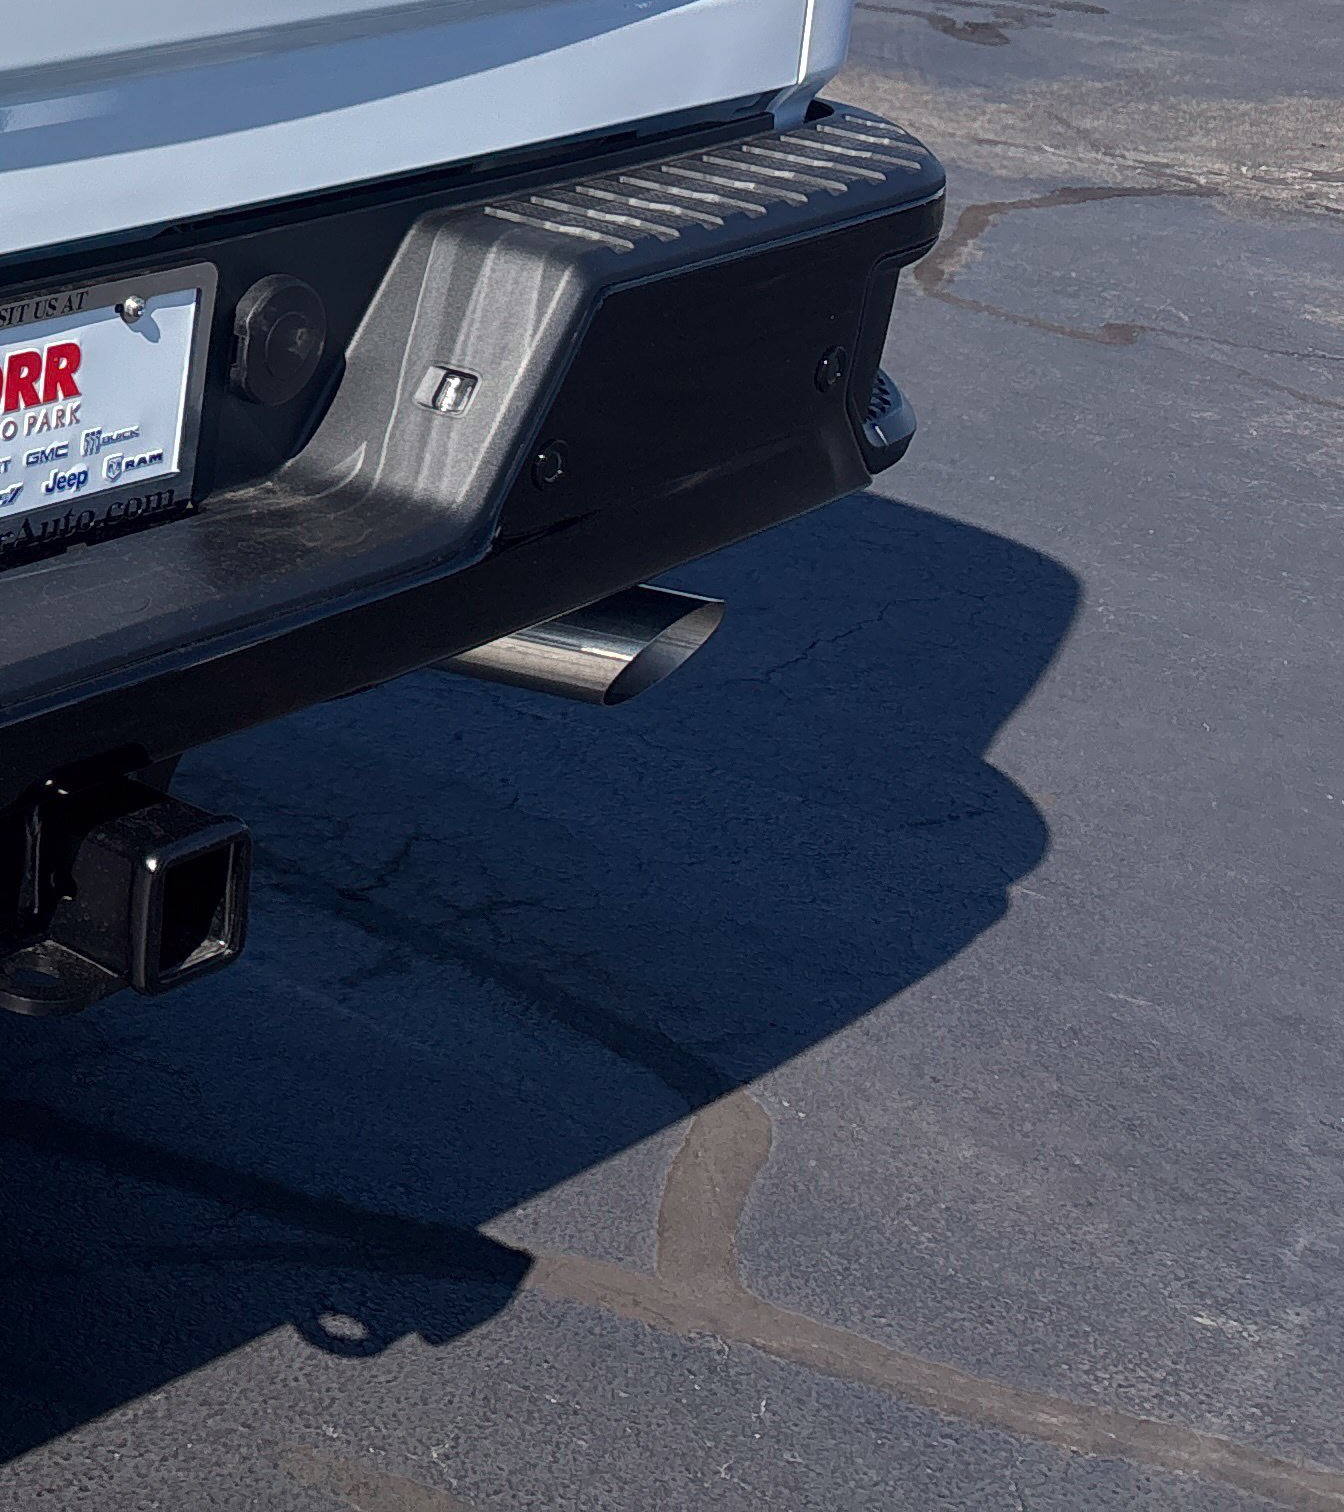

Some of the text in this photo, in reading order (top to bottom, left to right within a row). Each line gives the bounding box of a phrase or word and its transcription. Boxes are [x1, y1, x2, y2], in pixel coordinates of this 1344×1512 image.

[33, 297, 58, 320] US
[60, 290, 89, 315] AT
[25, 401, 81, 437] PARK
[25, 443, 70, 467] GMC
[42, 468, 89, 496] Jeep
[124, 451, 164, 472] RAM
